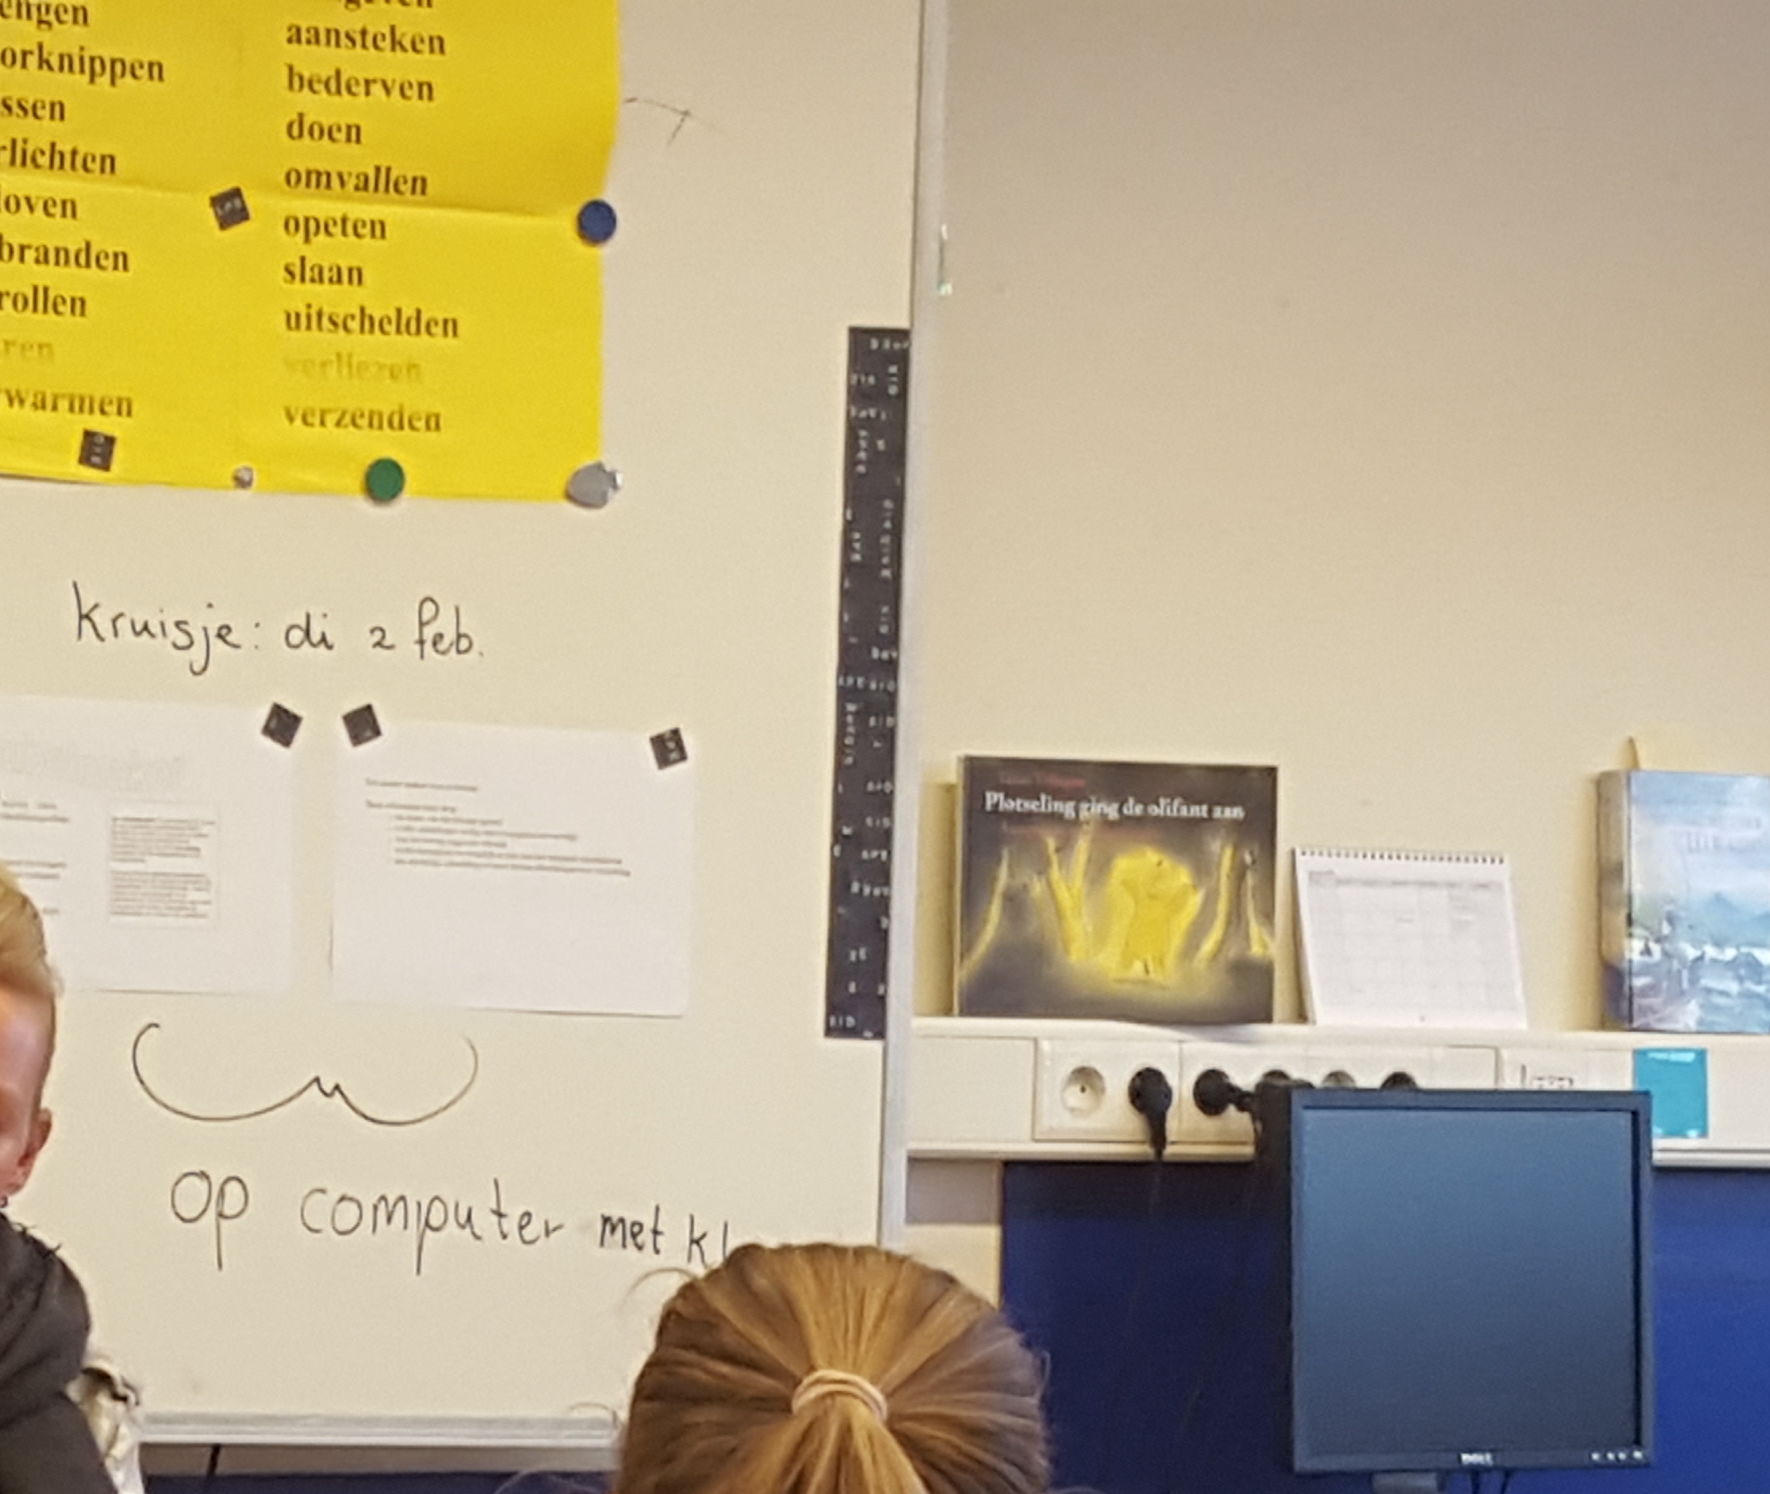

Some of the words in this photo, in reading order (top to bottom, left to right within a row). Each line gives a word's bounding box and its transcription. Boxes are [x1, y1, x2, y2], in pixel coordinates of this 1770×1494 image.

[287, 25, 445, 55] aansteken
[287, 64, 433, 101] bederven
[287, 113, 361, 144] doen
[285, 165, 427, 196] omvallen
[284, 215, 385, 244] opeten
[284, 256, 362, 286] slaan
[285, 303, 458, 337] uitschelden
[285, 405, 440, 432] verzenden
[285, 613, 333, 650] di
[370, 626, 395, 650] 2
[983, 790, 1076, 819] Plotseling
[1079, 796, 1119, 819] ging
[1122, 796, 1144, 817] de
[1147, 797, 1209, 819] olifant
[301, 1178, 563, 1275] computer
[600, 1205, 663, 1254] met
